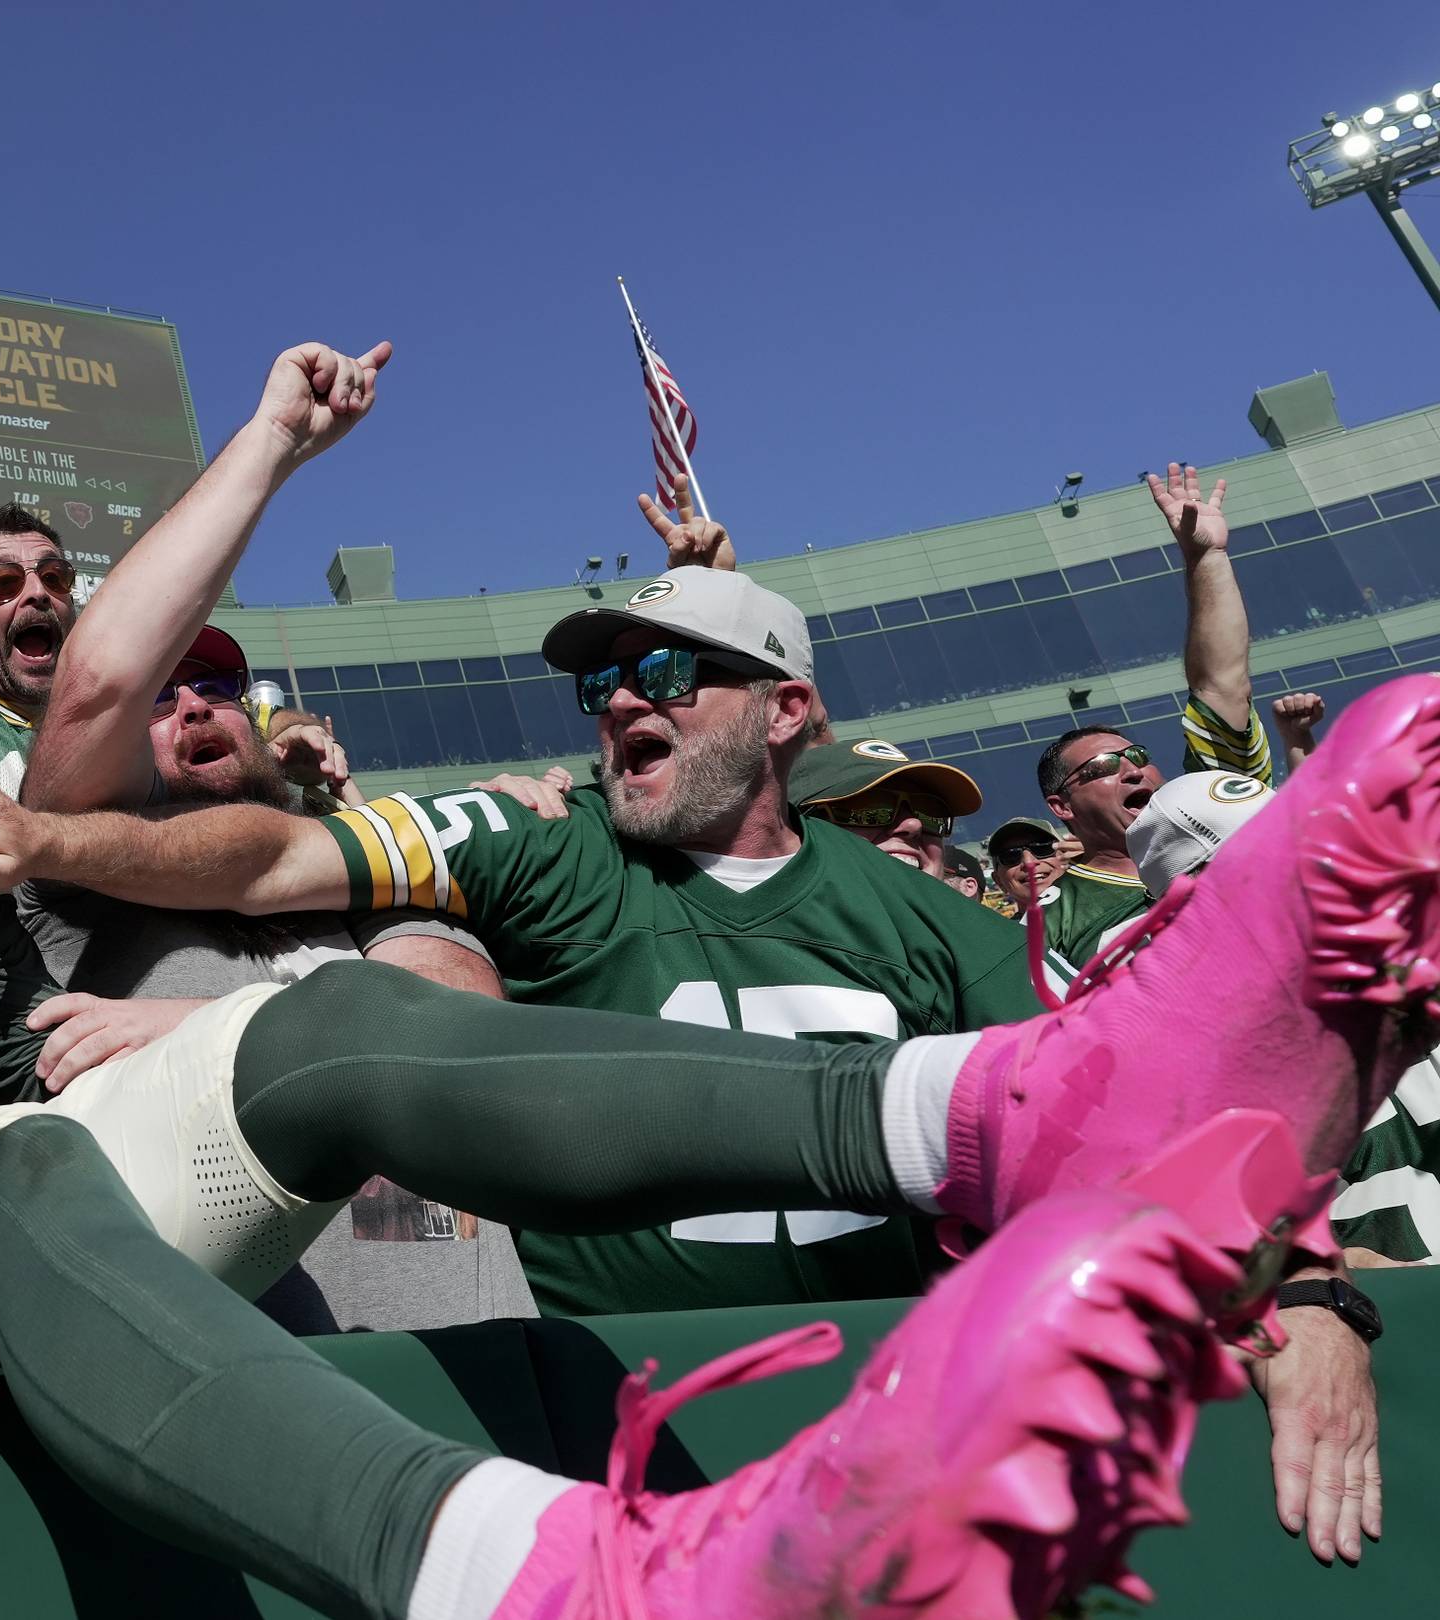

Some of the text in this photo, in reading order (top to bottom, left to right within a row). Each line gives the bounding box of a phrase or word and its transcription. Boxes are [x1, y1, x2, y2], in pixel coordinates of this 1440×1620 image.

[33, 450, 47, 466] IN
[51, 452, 77, 470] THE
[28, 467, 78, 487] ATRIUM
[107, 503, 141, 518] SACKS
[123, 519, 133, 535] 2
[76, 551, 111, 565] PASS
